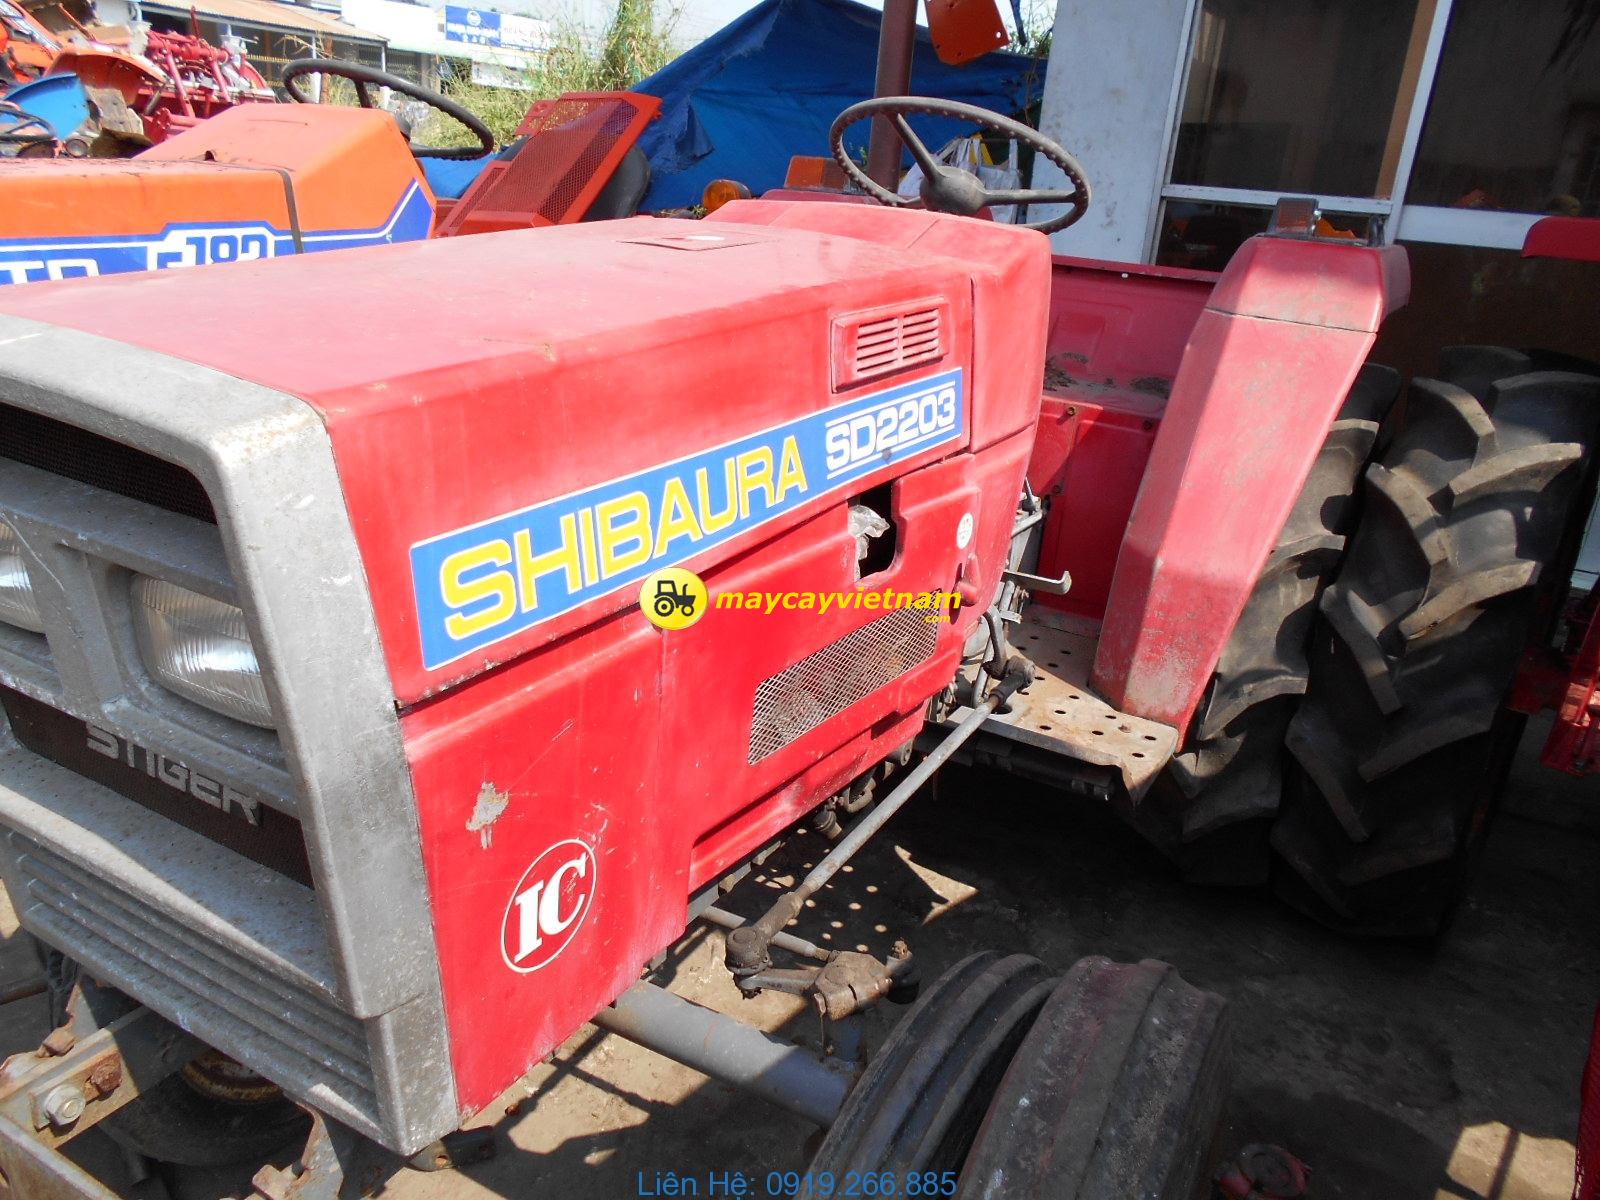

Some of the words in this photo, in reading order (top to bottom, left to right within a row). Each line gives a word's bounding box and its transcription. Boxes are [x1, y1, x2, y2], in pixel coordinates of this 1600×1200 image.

[826, 388, 956, 471] SD2203
[439, 435, 808, 641] SHIBAURA
[514, 852, 588, 963] IC
